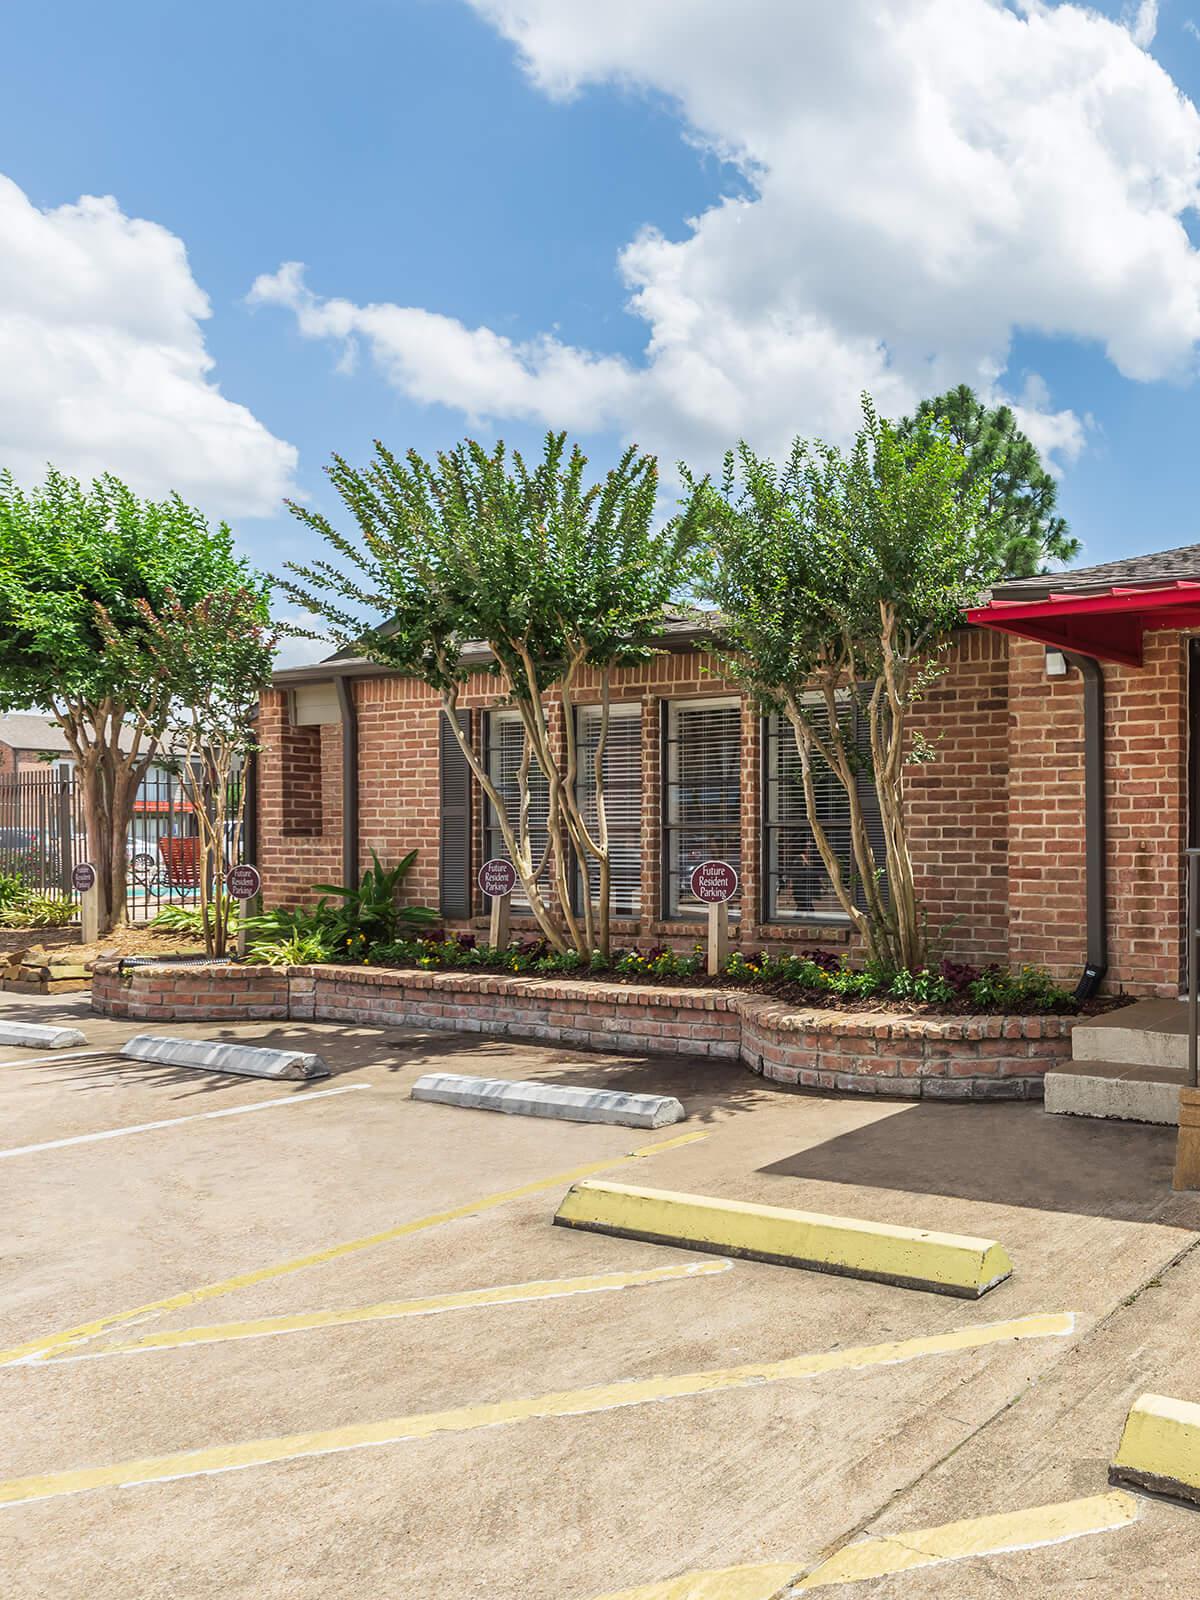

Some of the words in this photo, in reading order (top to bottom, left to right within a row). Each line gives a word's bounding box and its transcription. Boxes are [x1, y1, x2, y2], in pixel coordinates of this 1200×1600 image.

[488, 863, 507, 872] Future
[702, 865, 726, 876] Future
[235, 869, 252, 877] Future
[485, 872, 509, 881] Resident
[232, 877, 254, 886] Resident
[699, 876, 728, 886] Resident
[232, 886, 253, 897] Parking
[485, 882, 508, 894] Parking
[700, 886, 727, 900] Parking
